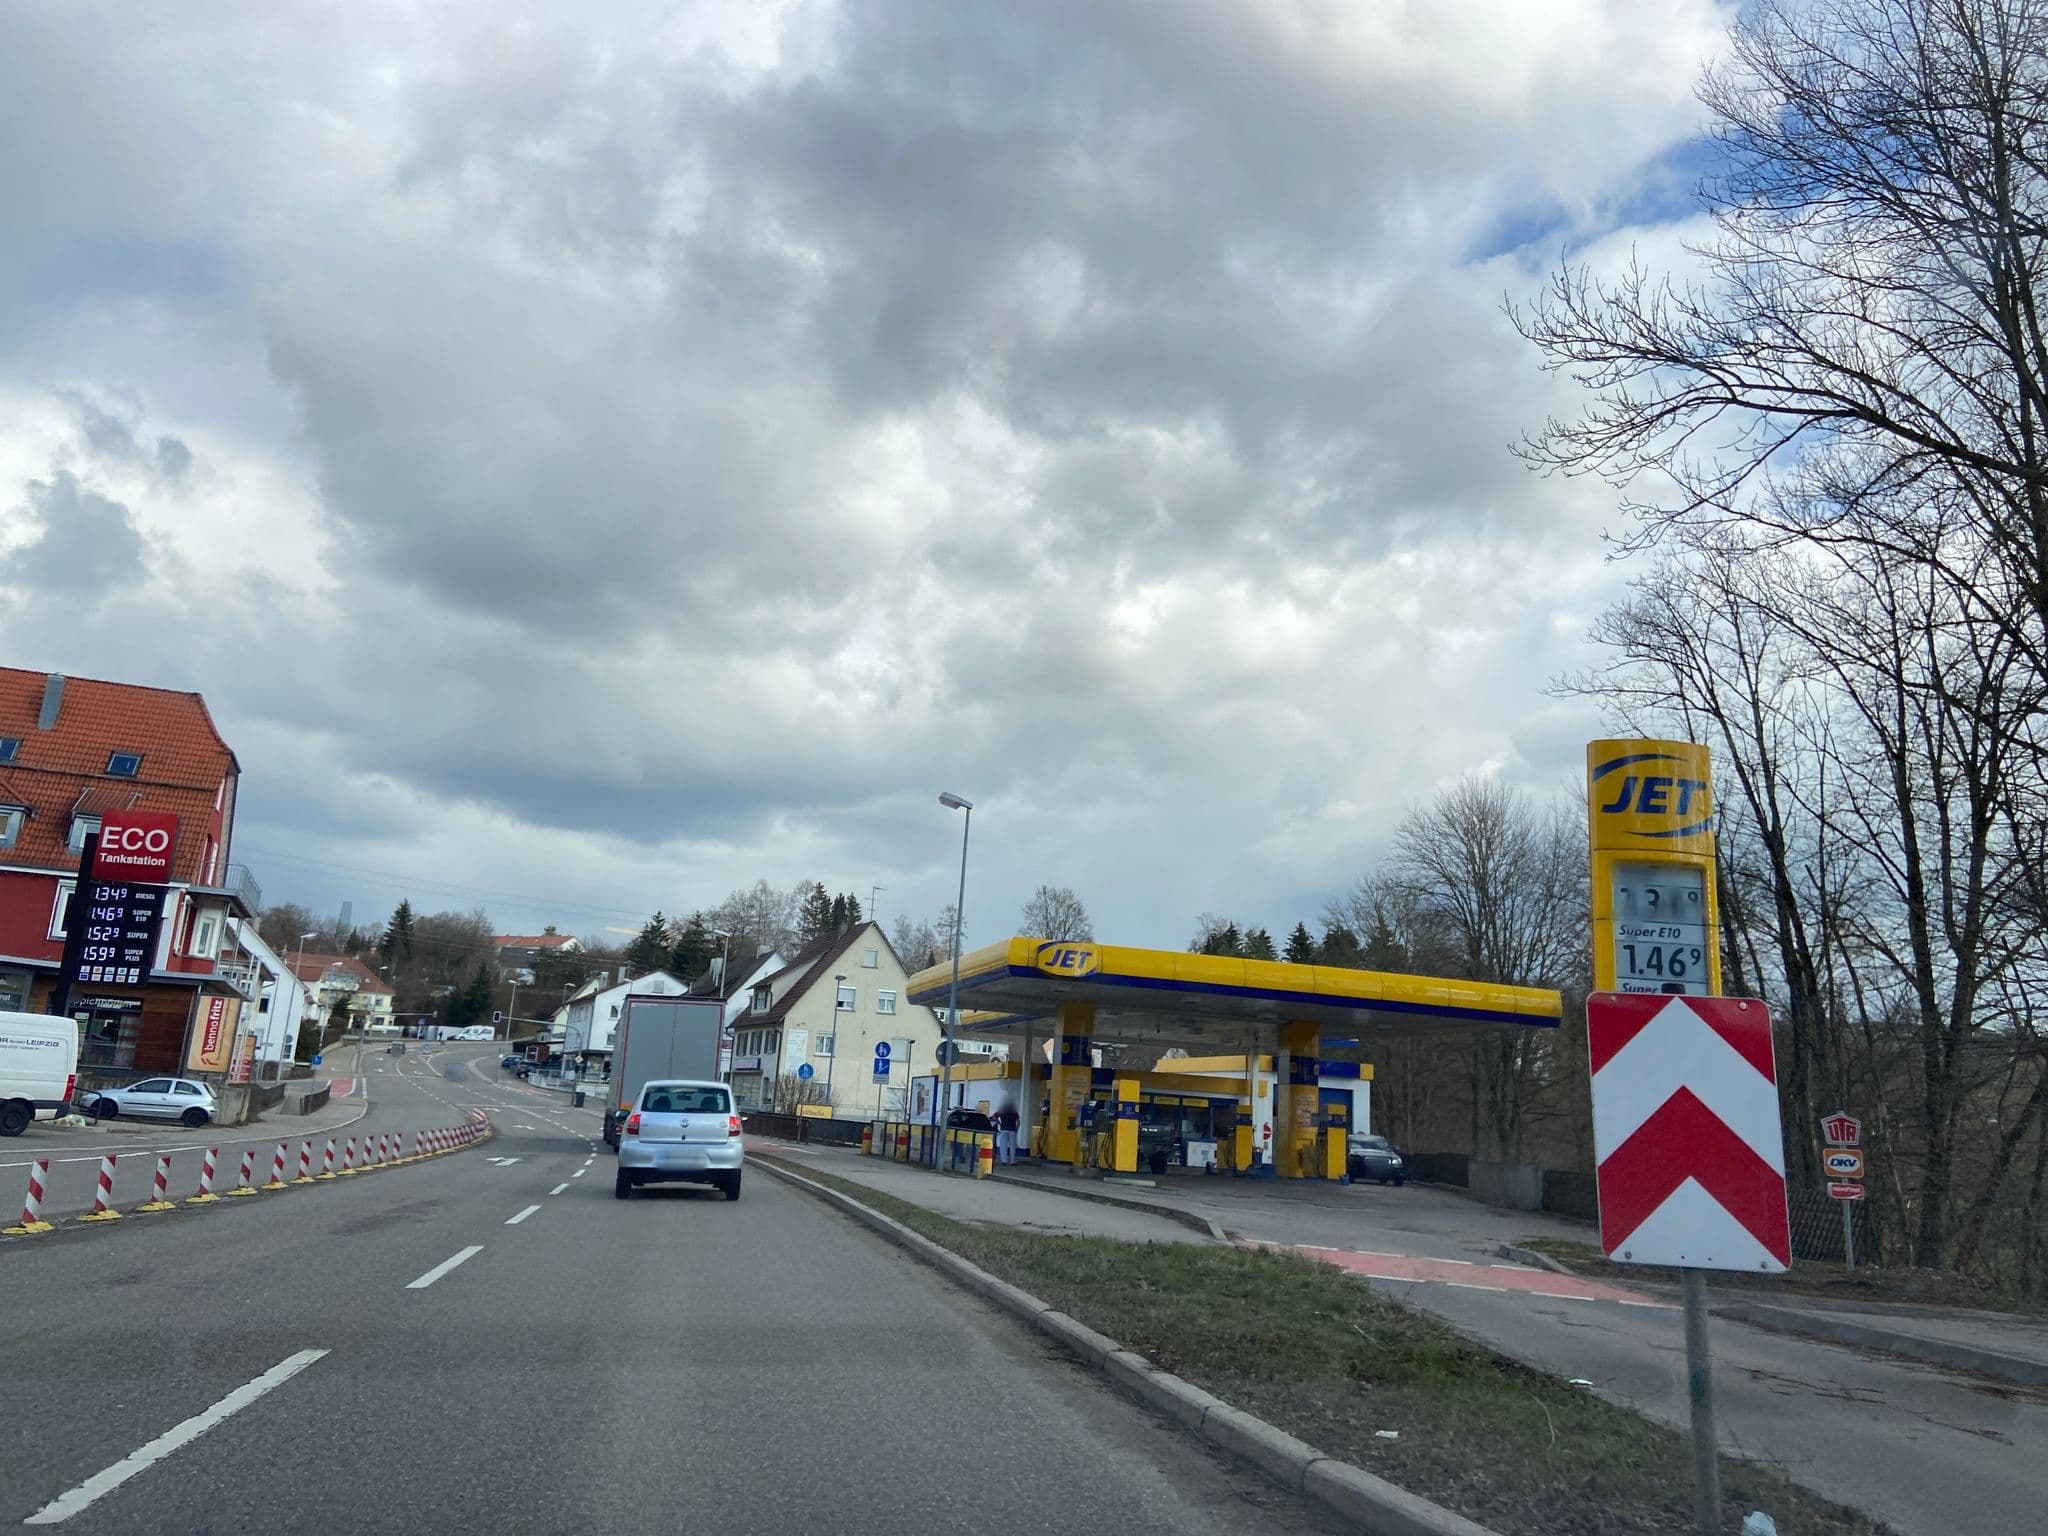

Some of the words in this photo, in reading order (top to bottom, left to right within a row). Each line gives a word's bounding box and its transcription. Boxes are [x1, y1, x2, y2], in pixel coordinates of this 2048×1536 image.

[1601, 776, 1706, 815] JET
[101, 826, 169, 852] ECO
[100, 852, 166, 867] Tankstation
[126, 931, 149, 939] SUPER
[1619, 924, 1657, 938] Super
[1658, 927, 1681, 938] E10
[1045, 949, 1093, 968] JET
[1622, 944, 1701, 977] 1.469
[1827, 1117, 1858, 1141] UTA
[1830, 1158, 1857, 1168] DKV
